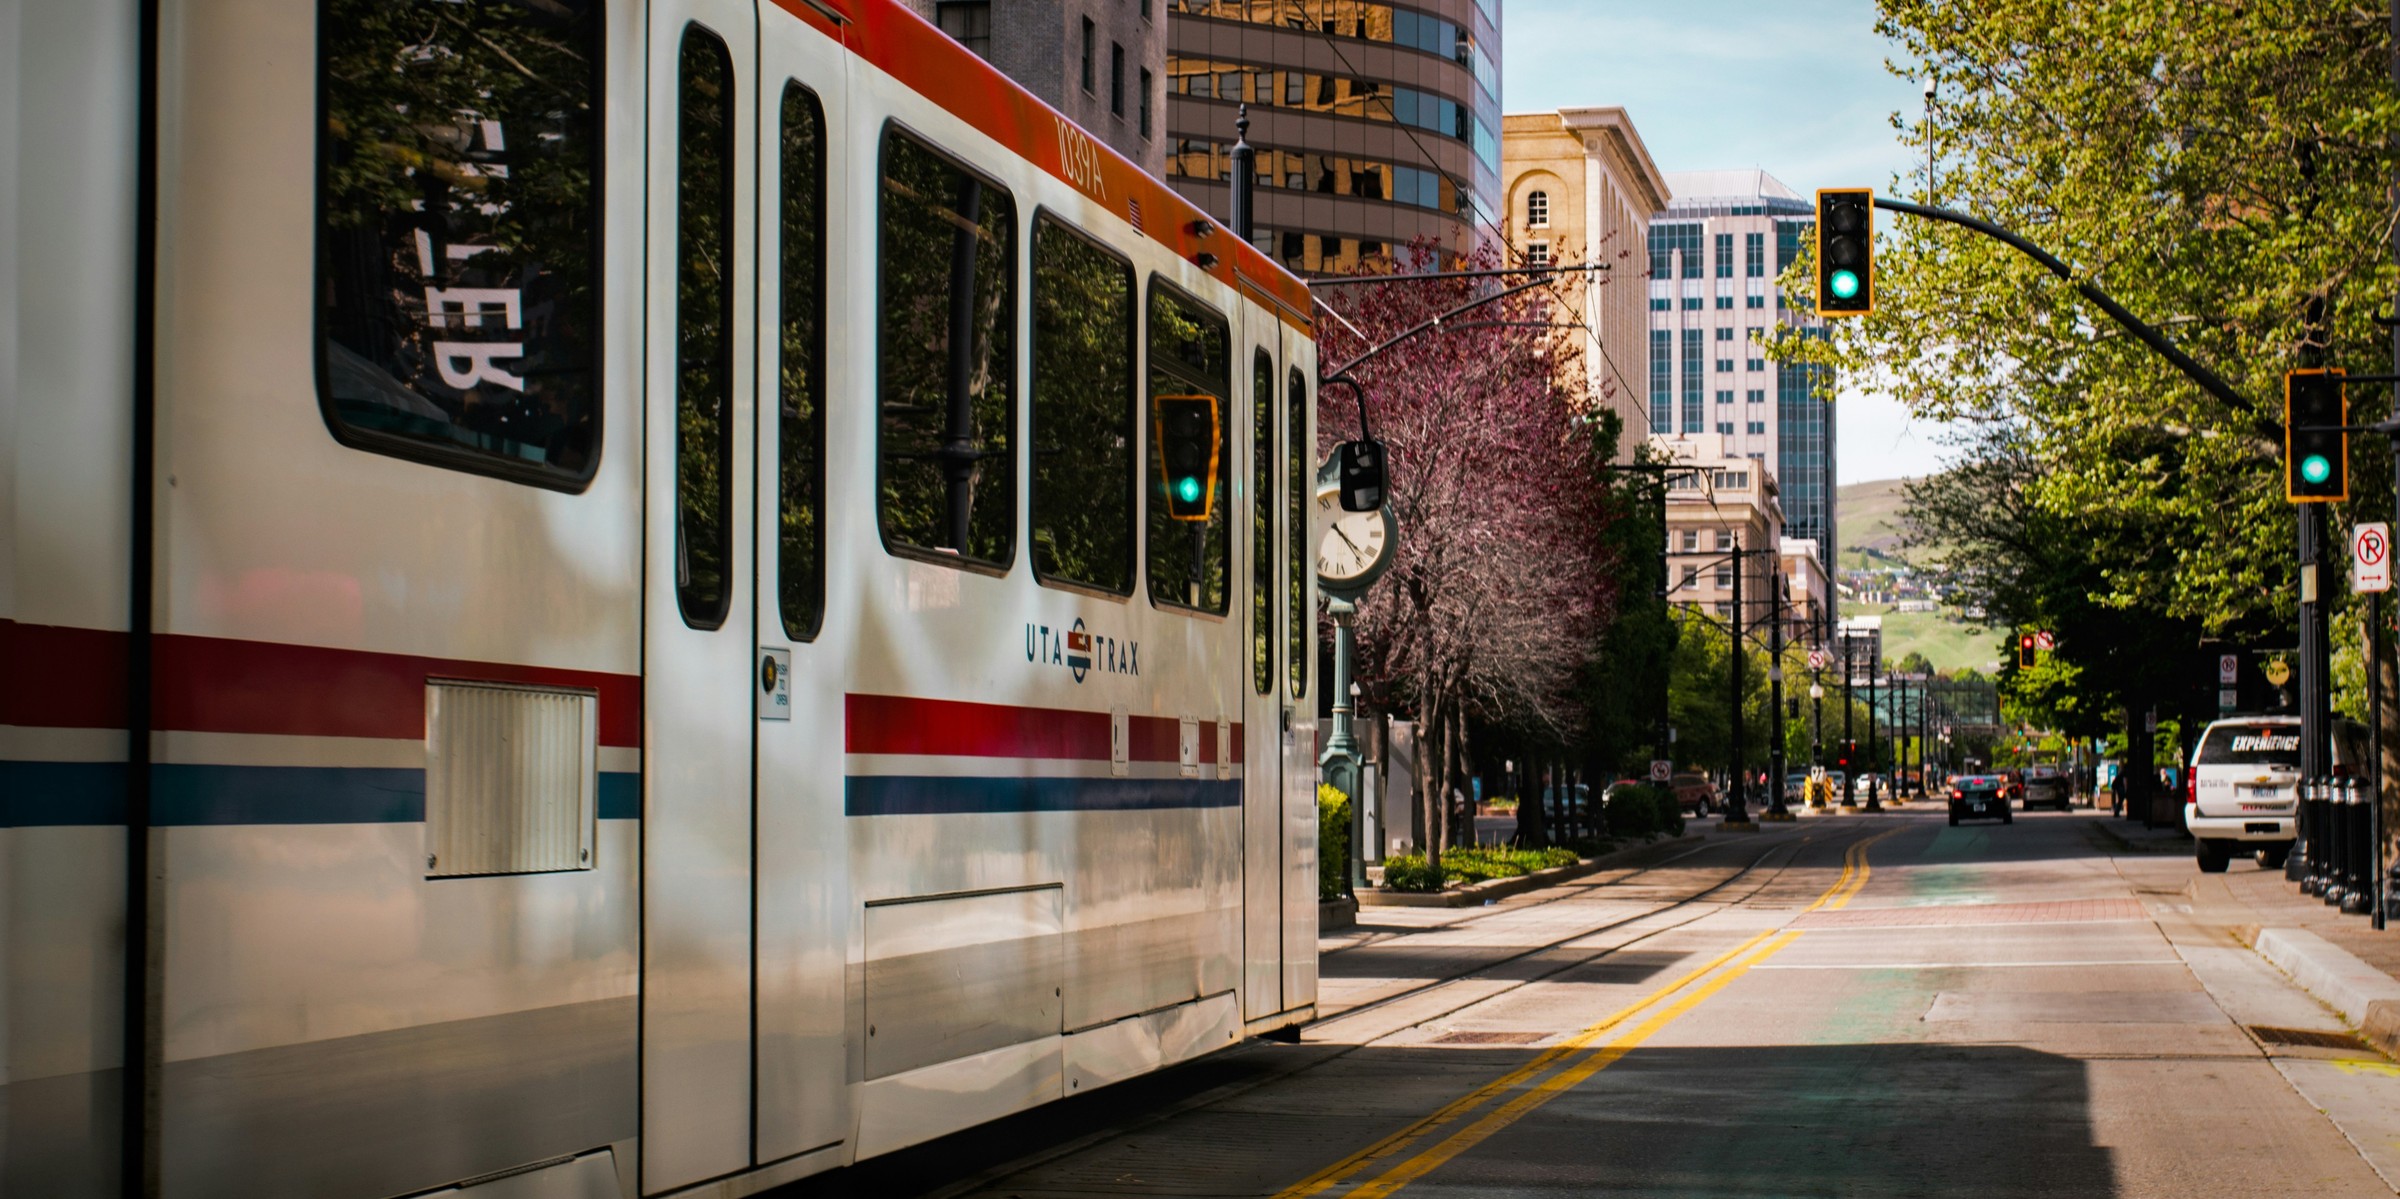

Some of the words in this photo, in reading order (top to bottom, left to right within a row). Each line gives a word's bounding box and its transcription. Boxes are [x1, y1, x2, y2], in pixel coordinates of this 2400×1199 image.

[1054, 115, 1106, 201] 1039A
[1026, 622, 1062, 666] UTA
[1096, 635, 1139, 676] TRAX
[2231, 735, 2300, 753] EXPERIENCE
